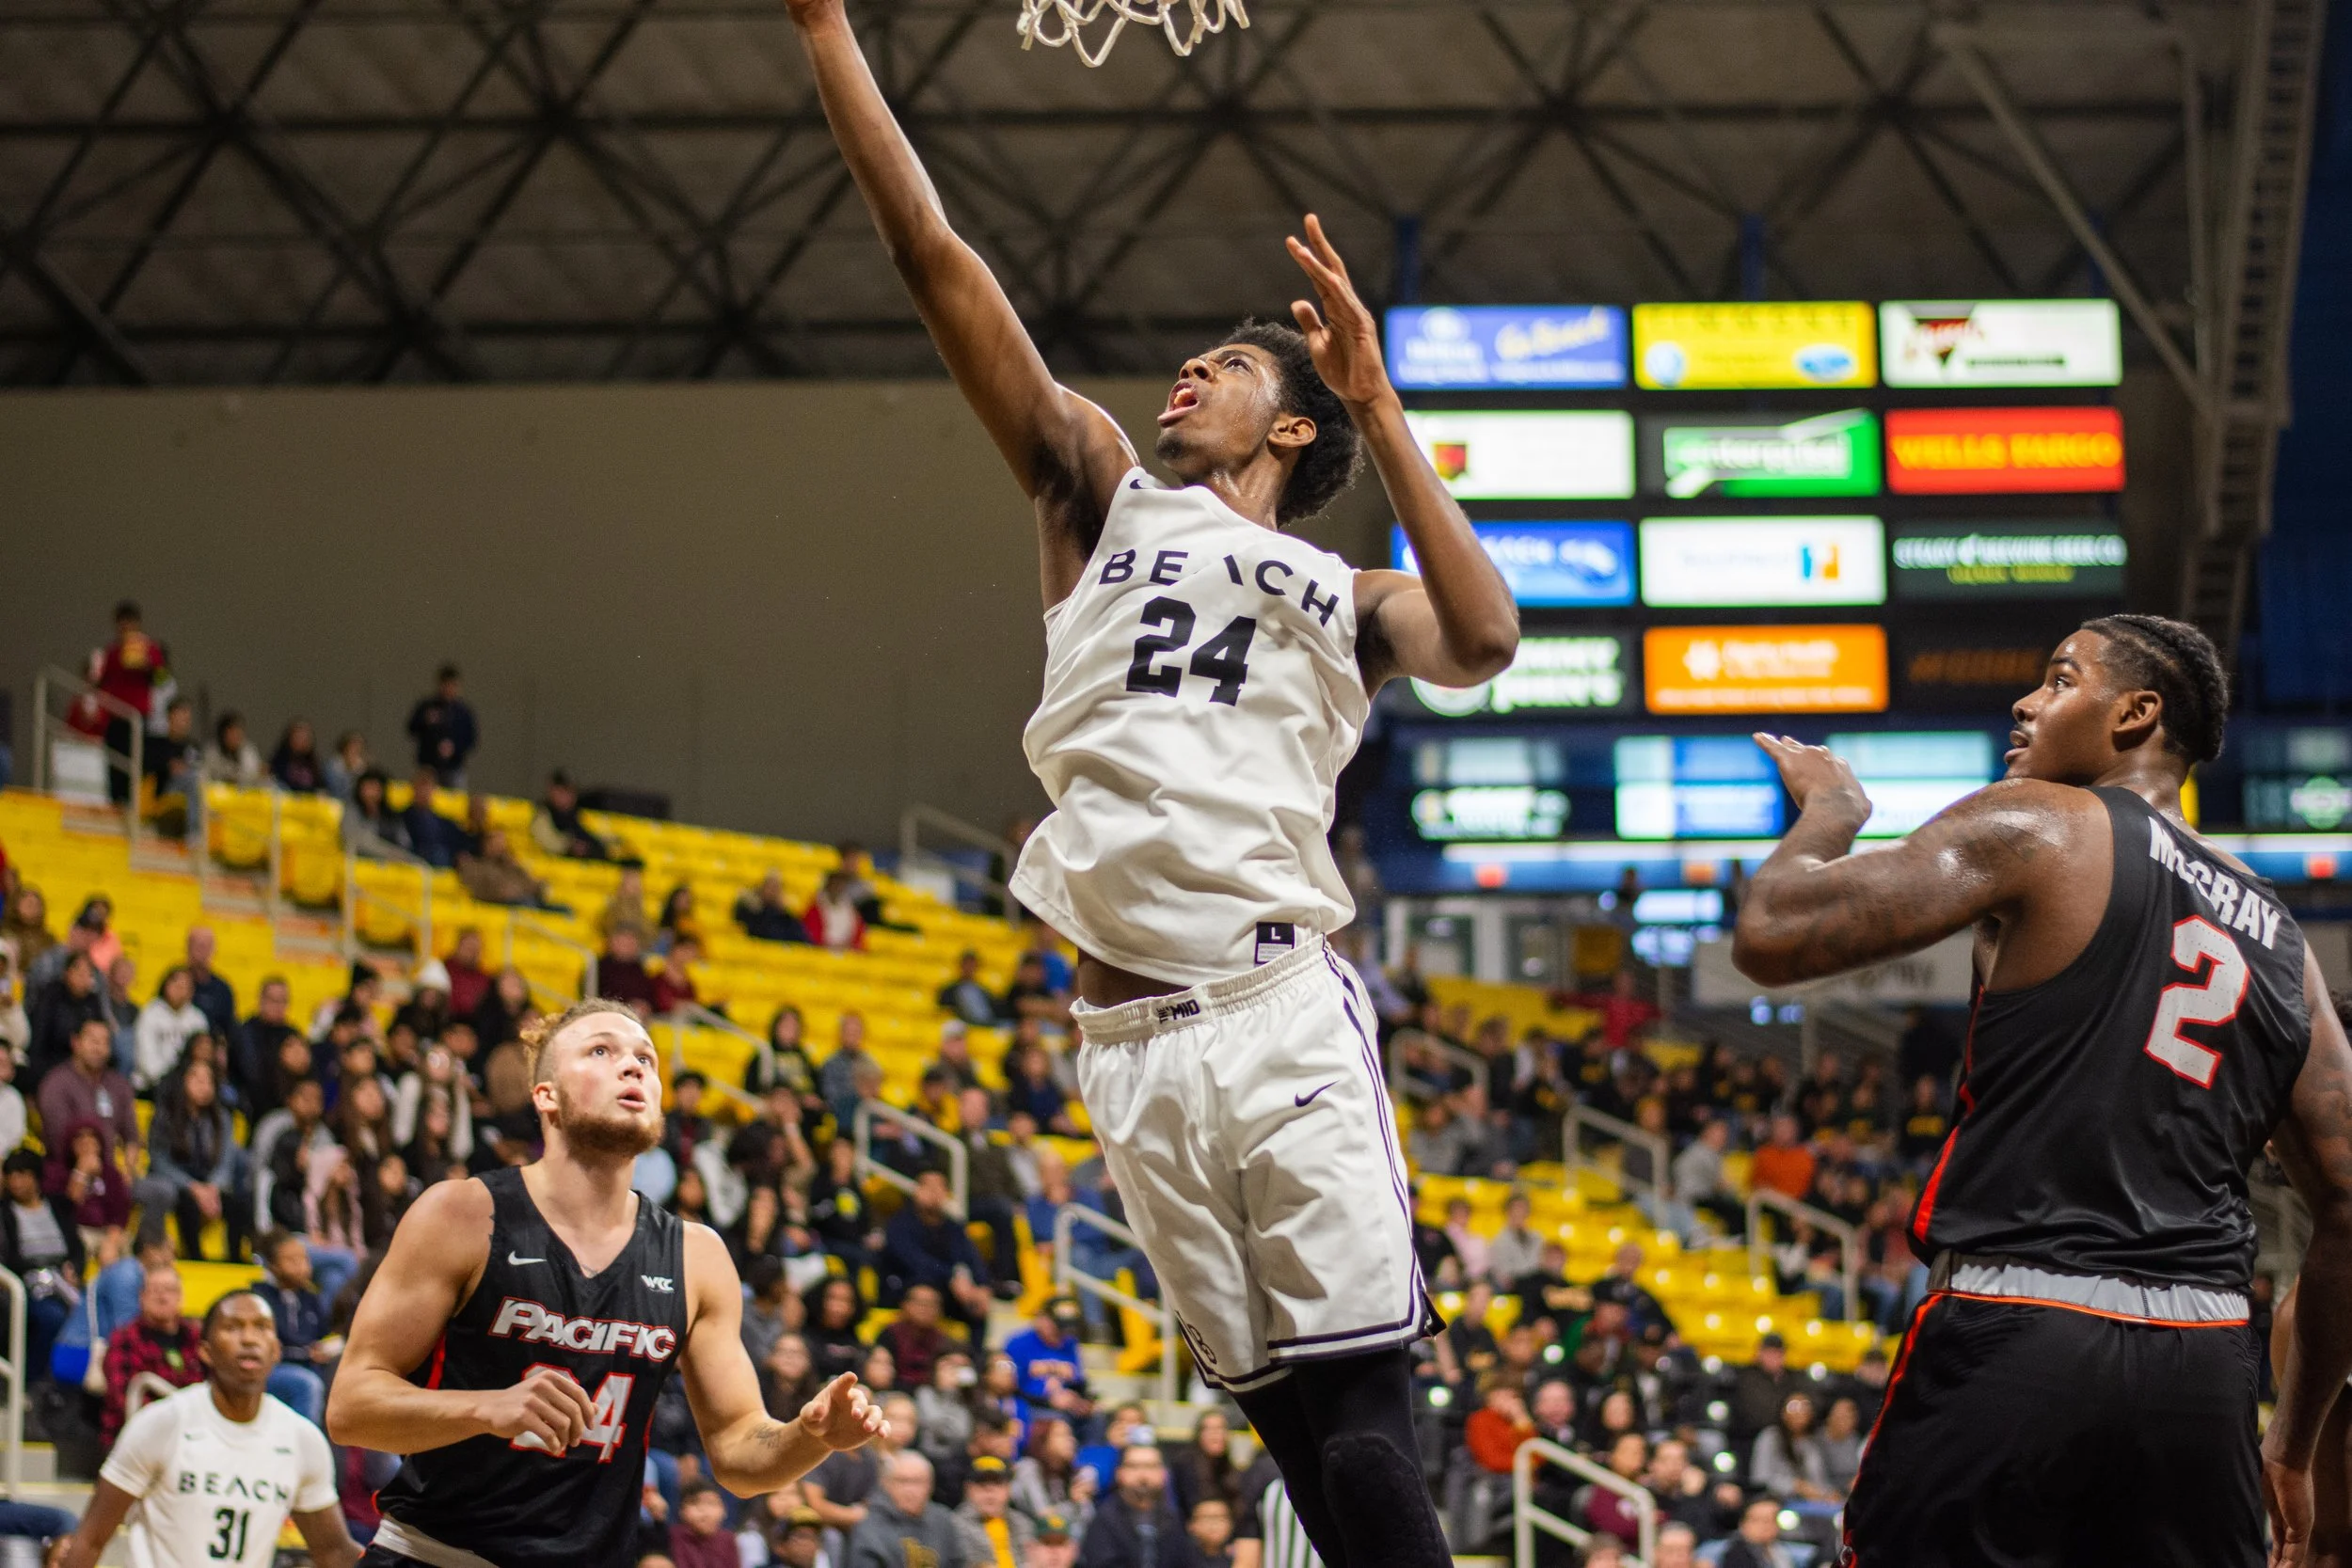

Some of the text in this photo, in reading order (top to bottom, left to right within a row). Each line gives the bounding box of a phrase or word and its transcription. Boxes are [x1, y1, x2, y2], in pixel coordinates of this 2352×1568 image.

[1126, 596, 1256, 706] 24
[1271, 927, 1281, 940] L
[2144, 914, 2249, 1089] 2
[487, 1296, 676, 1362] PACIFIC
[179, 1469, 290, 1503] BEACH
[208, 1505, 250, 1561] 31
